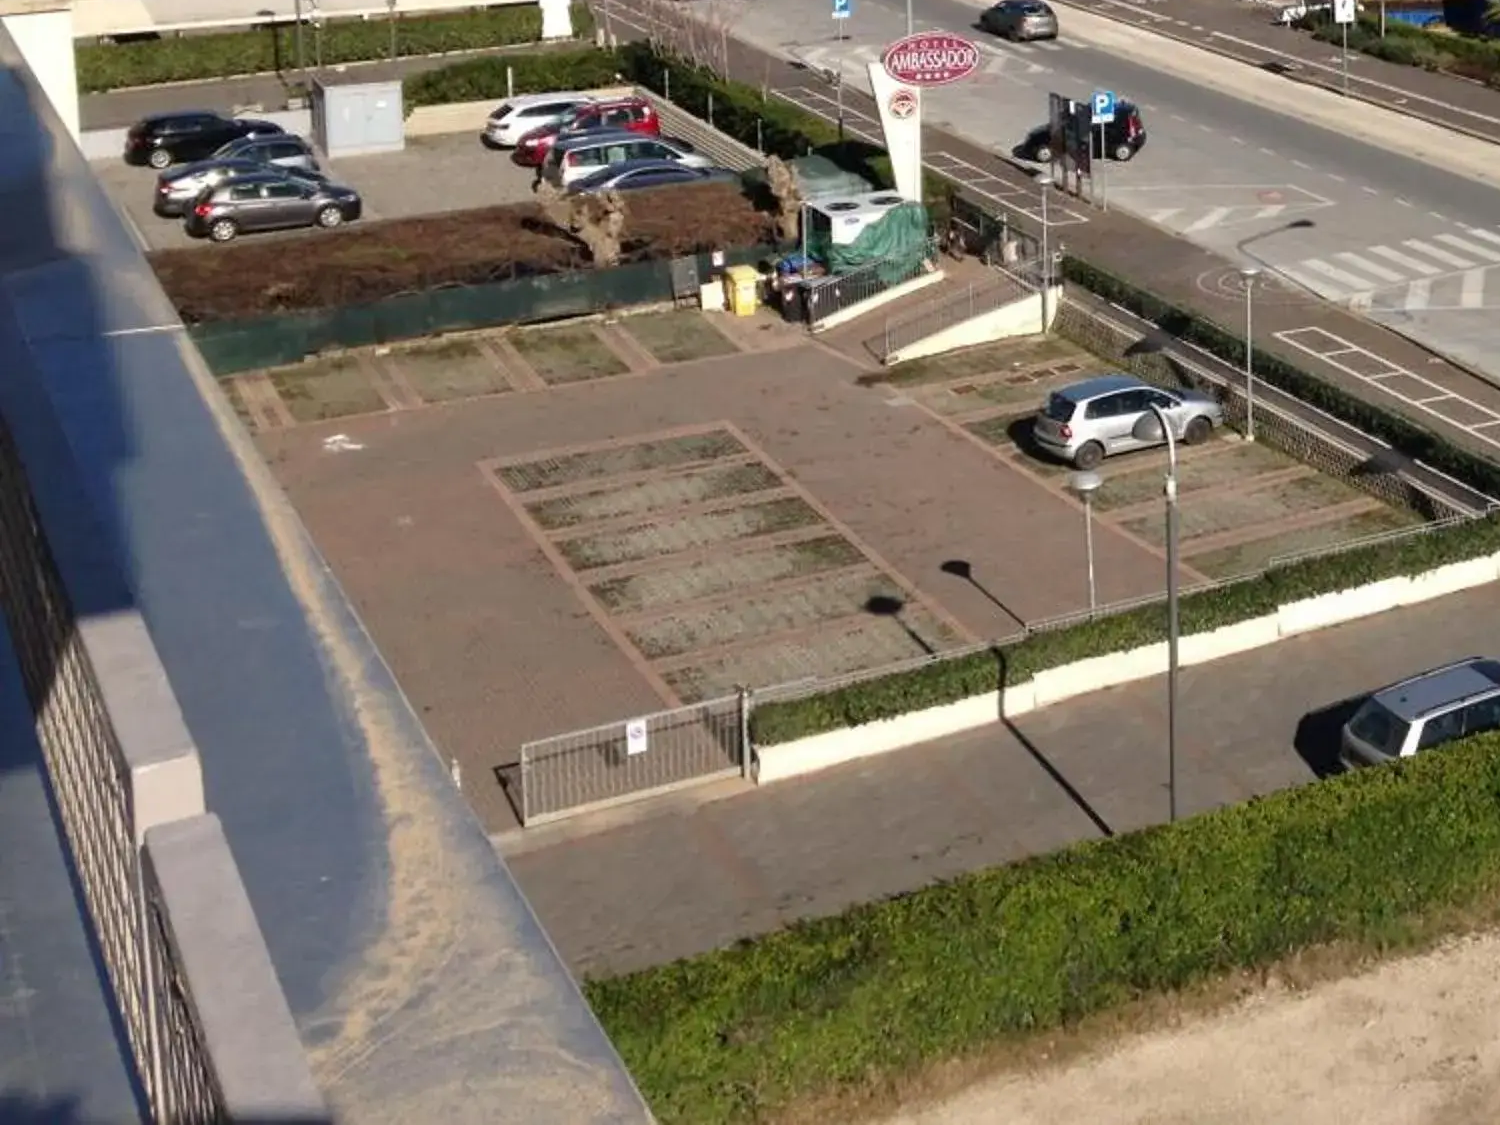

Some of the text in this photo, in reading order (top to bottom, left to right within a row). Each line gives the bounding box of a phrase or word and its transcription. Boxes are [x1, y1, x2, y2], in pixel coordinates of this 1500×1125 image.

[907, 38, 960, 50] HOTEL
[891, 47, 977, 72] AMBASSADOR
[1095, 94, 1110, 115] P
